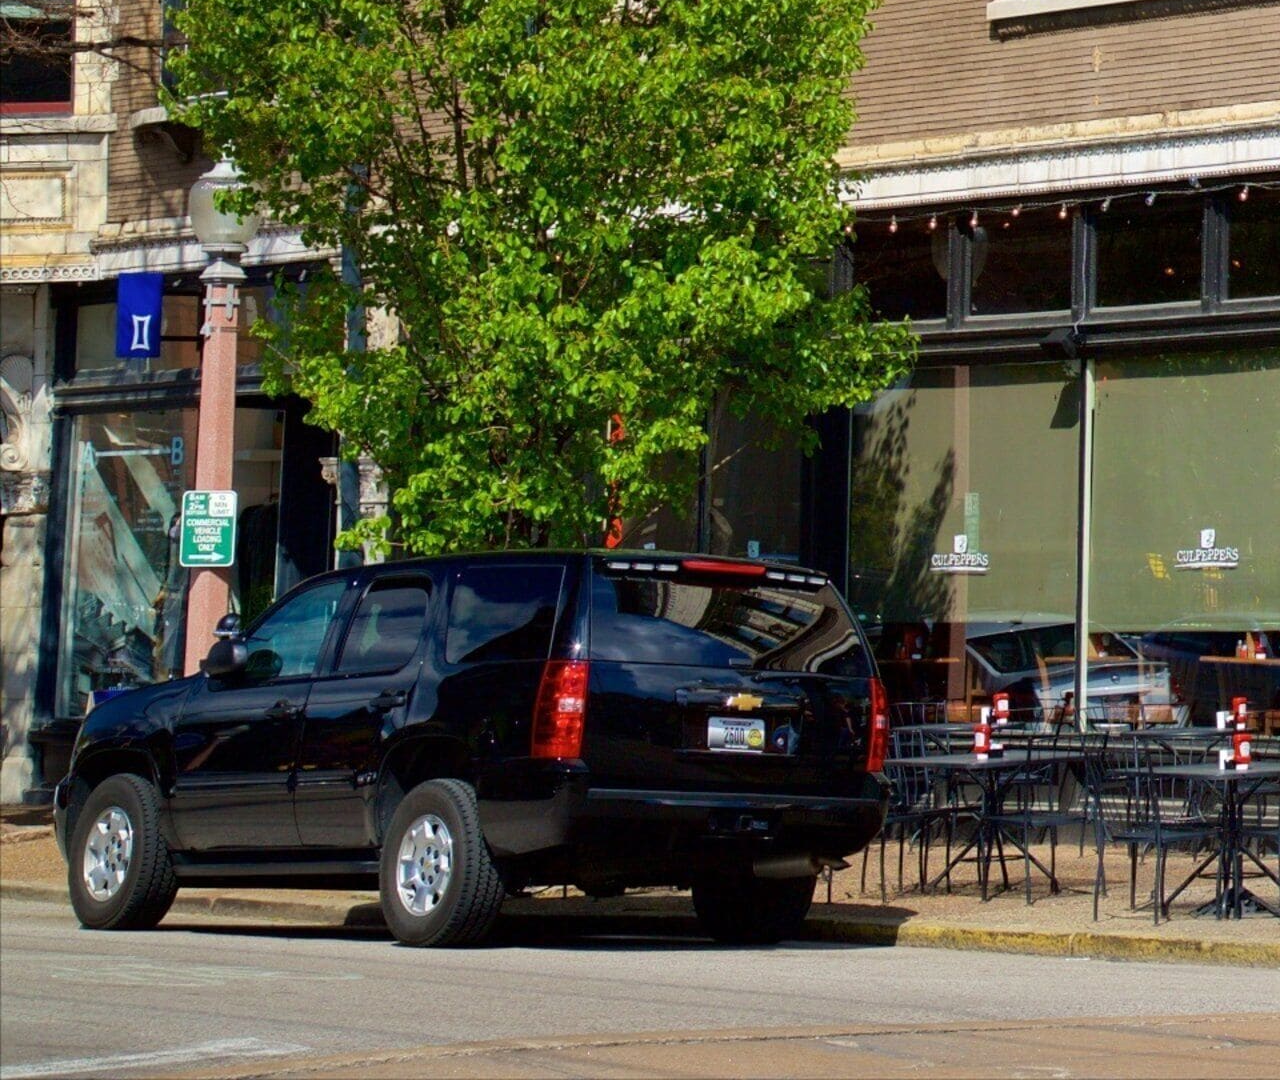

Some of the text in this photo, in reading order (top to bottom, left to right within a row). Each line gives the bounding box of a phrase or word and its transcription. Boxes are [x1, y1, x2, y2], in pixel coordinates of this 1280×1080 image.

[186, 519, 230, 527] COMMERCIAL
[194, 526, 222, 535] VEHICLE
[192, 535, 223, 544] LOADING
[198, 543, 216, 552] ONLY
[1176, 547, 1239, 562] CULPEPPERS
[931, 553, 989, 566] CULPEPPERS
